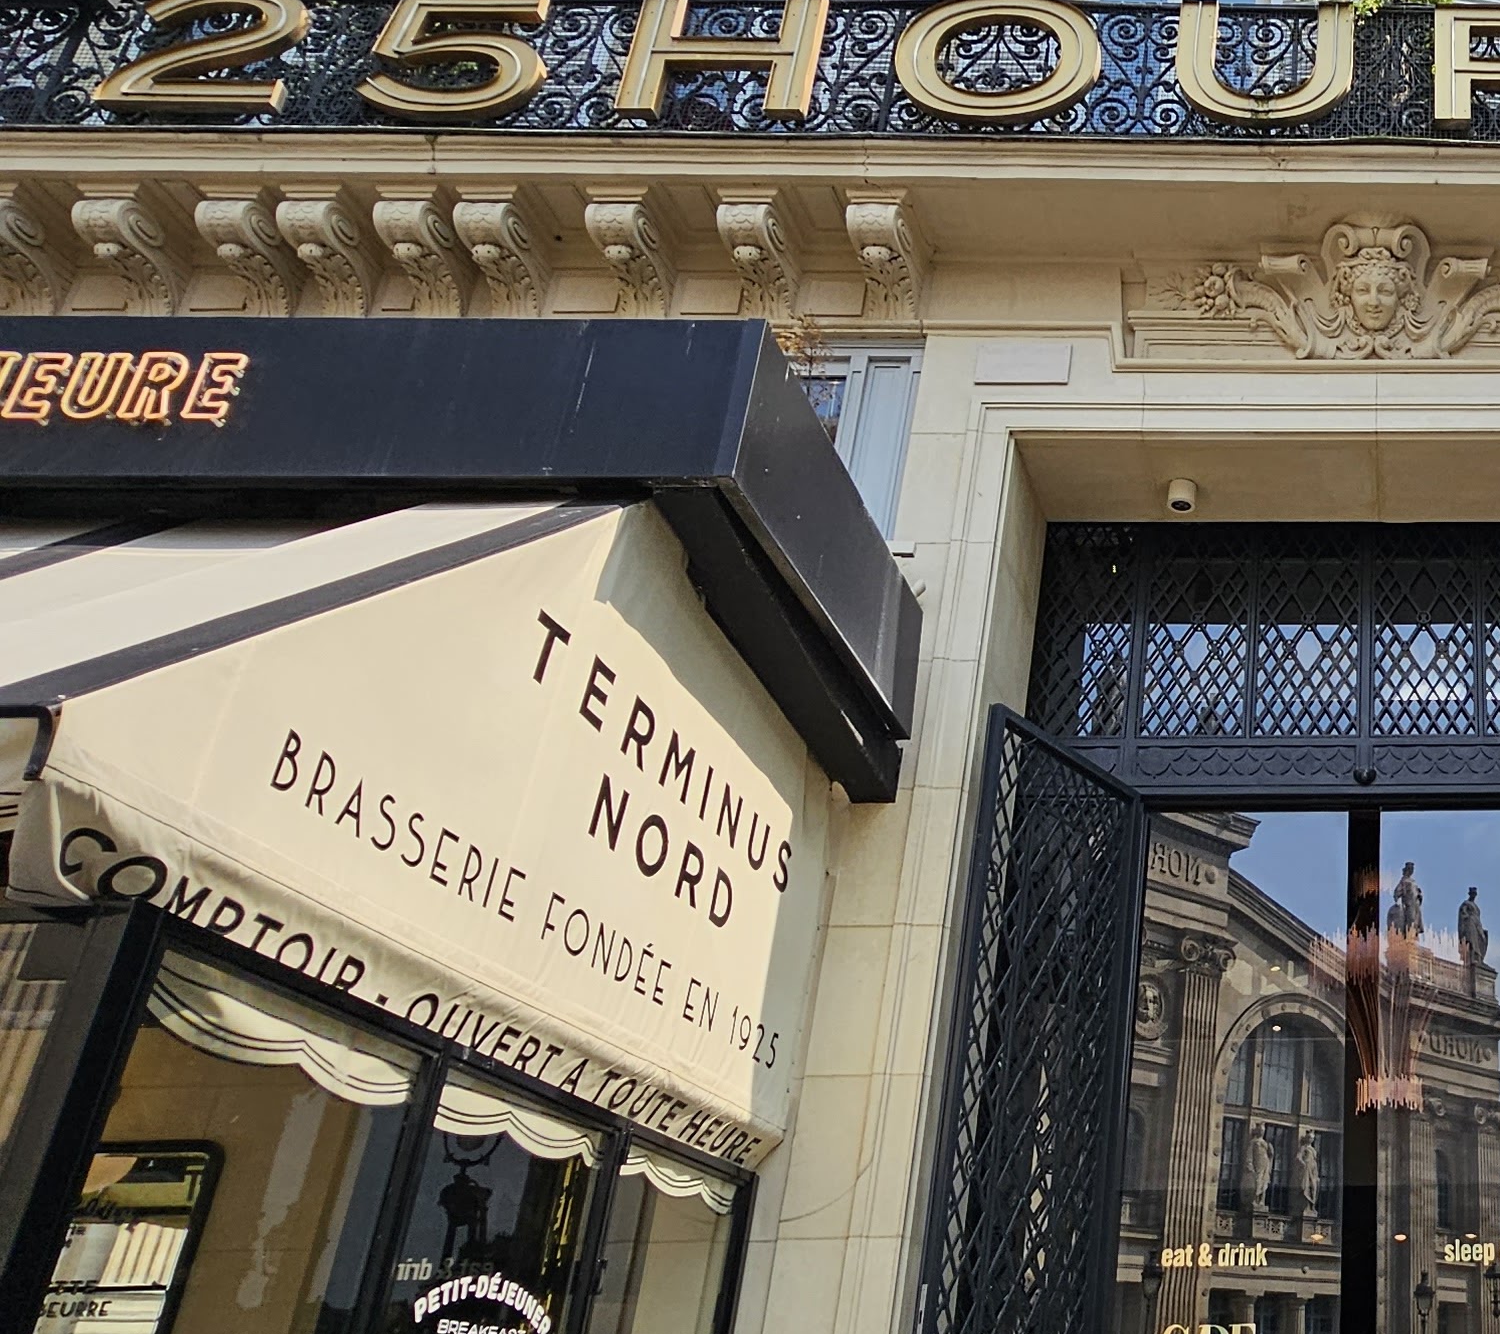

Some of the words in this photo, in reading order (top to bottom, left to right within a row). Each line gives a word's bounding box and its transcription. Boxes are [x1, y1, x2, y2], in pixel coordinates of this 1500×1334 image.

[532, 608, 793, 893] TERMINUS
[587, 772, 734, 928] NORD
[60, 827, 366, 998] COMPTOIR
[404, 992, 564, 1079] OUVERT
[594, 1069, 687, 1135] TOUTE
[679, 1109, 763, 1167] HEURE
[269, 727, 527, 923] BRASSERIE
[540, 891, 672, 1006] FONDÉE
[682, 977, 720, 1032] EN
[730, 1005, 780, 1070] 1925
[1161, 1244, 1194, 1267] eat
[1198, 1242, 1213, 1267] &
[1218, 1242, 1269, 1267] drink
[1444, 1238, 1495, 1265] sleep
